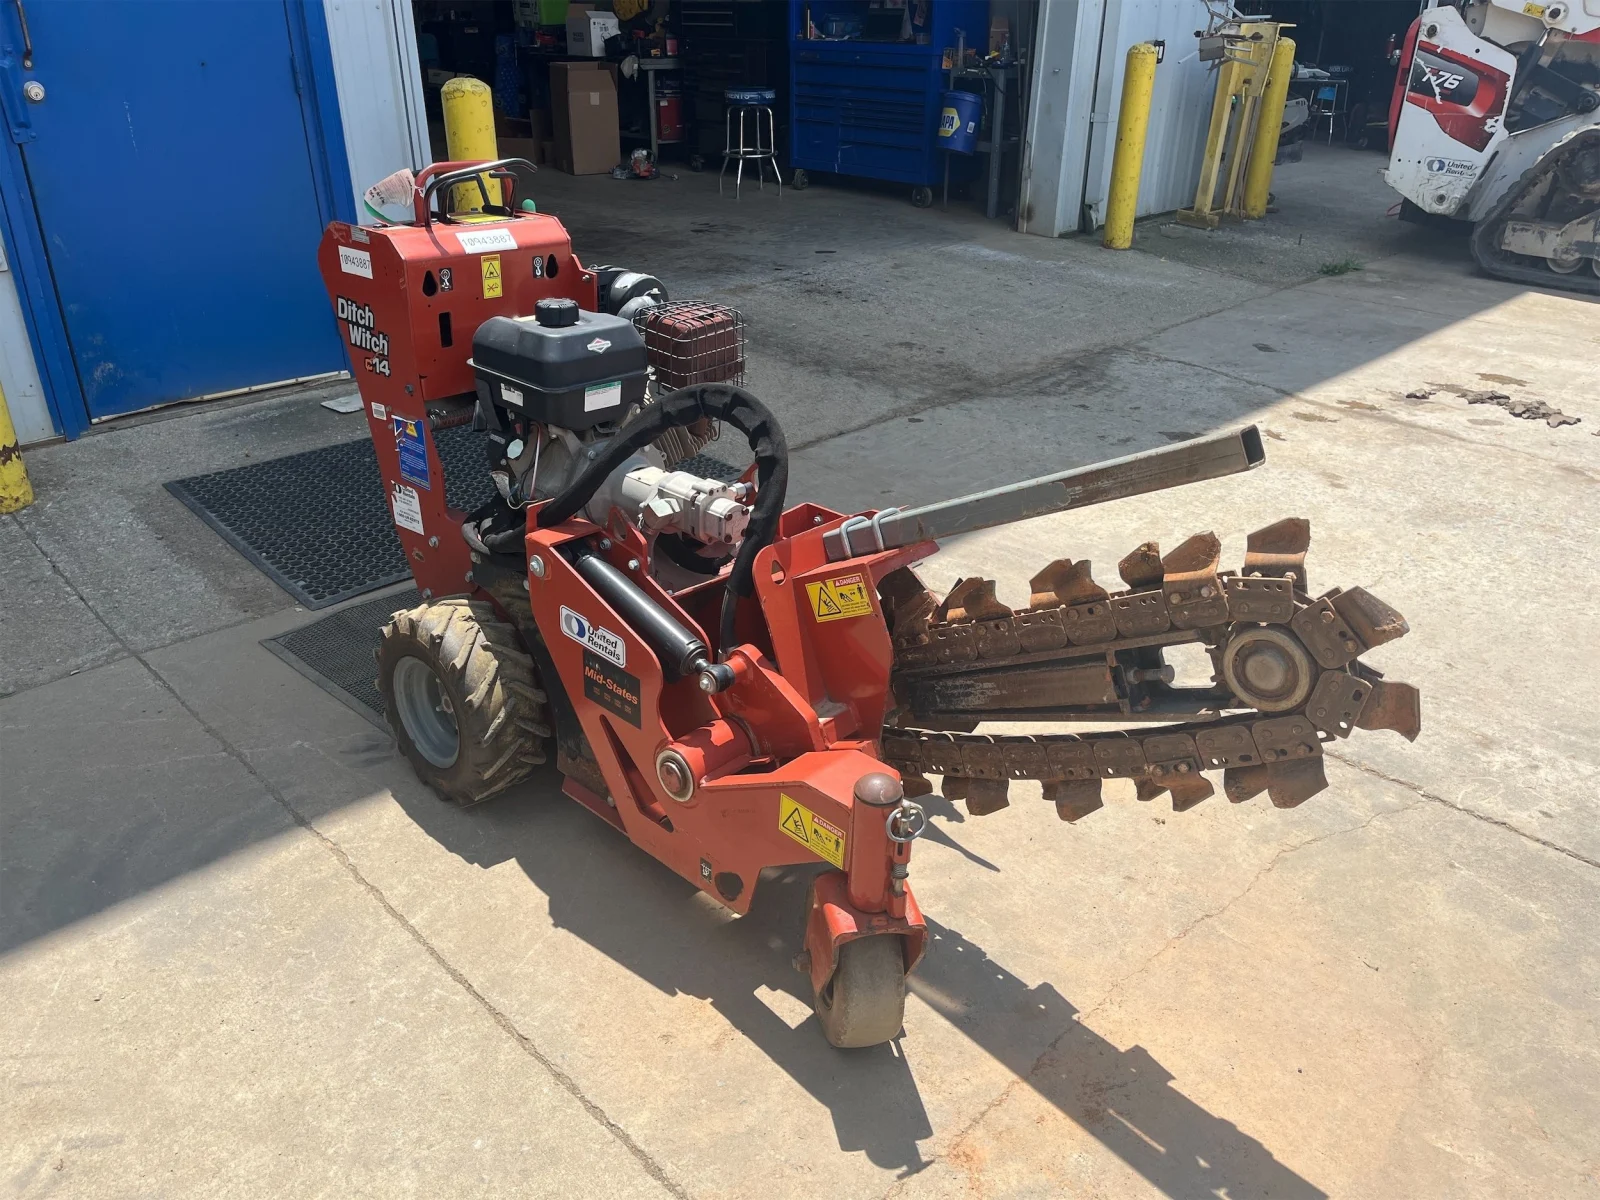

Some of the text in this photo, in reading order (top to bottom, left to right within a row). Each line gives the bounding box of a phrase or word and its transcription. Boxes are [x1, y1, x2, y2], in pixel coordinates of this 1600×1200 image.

[1447, 161, 1473, 170] United
[462, 234, 512, 247] 10943887
[340, 253, 371, 270] 10943887
[337, 296, 374, 328] Ditch
[348, 323, 388, 356] Witch
[840, 576, 861, 586] DANGER
[587, 625, 618, 649] United
[587, 636, 621, 660] Rentals
[584, 666, 638, 705] Mid-States
[819, 818, 843, 838] DANGER
